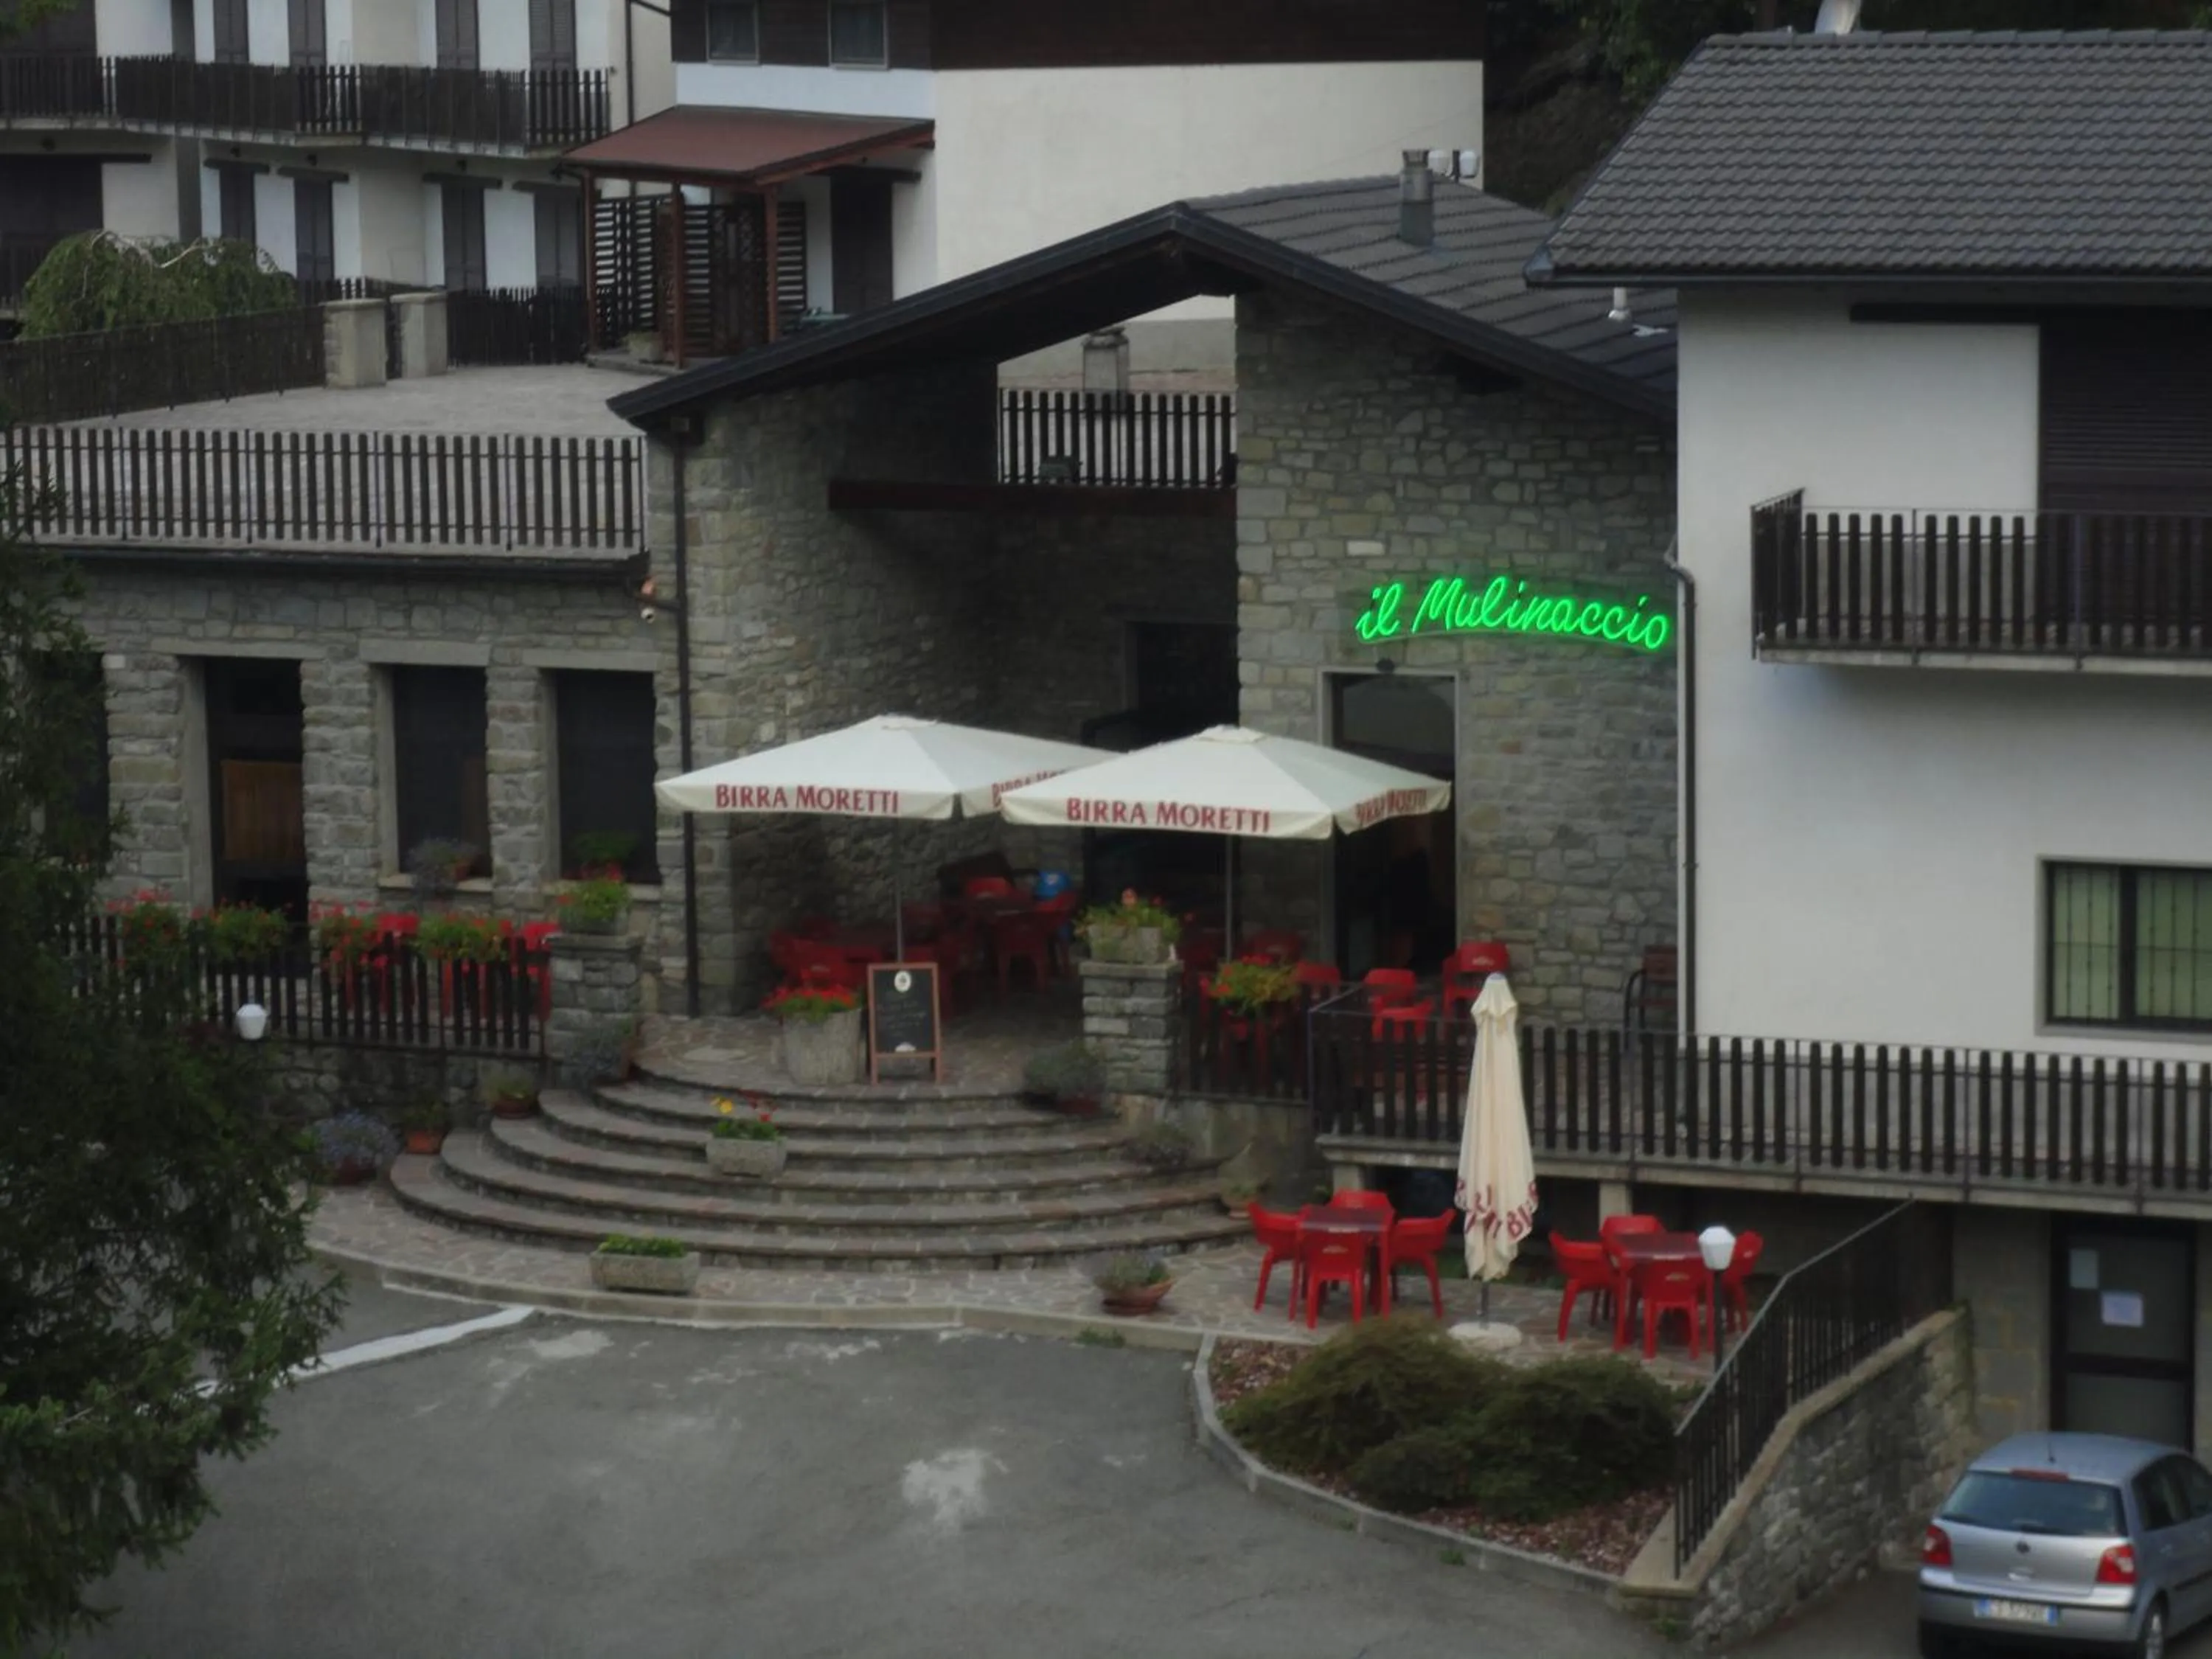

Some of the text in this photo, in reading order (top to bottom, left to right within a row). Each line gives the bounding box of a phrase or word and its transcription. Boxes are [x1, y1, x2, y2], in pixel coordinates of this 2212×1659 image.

[1355, 575, 1670, 650] il Mulinaccio
[715, 784, 899, 814] BIRRA MORETTI
[1065, 796, 1270, 833] BIRRA MORETTI
